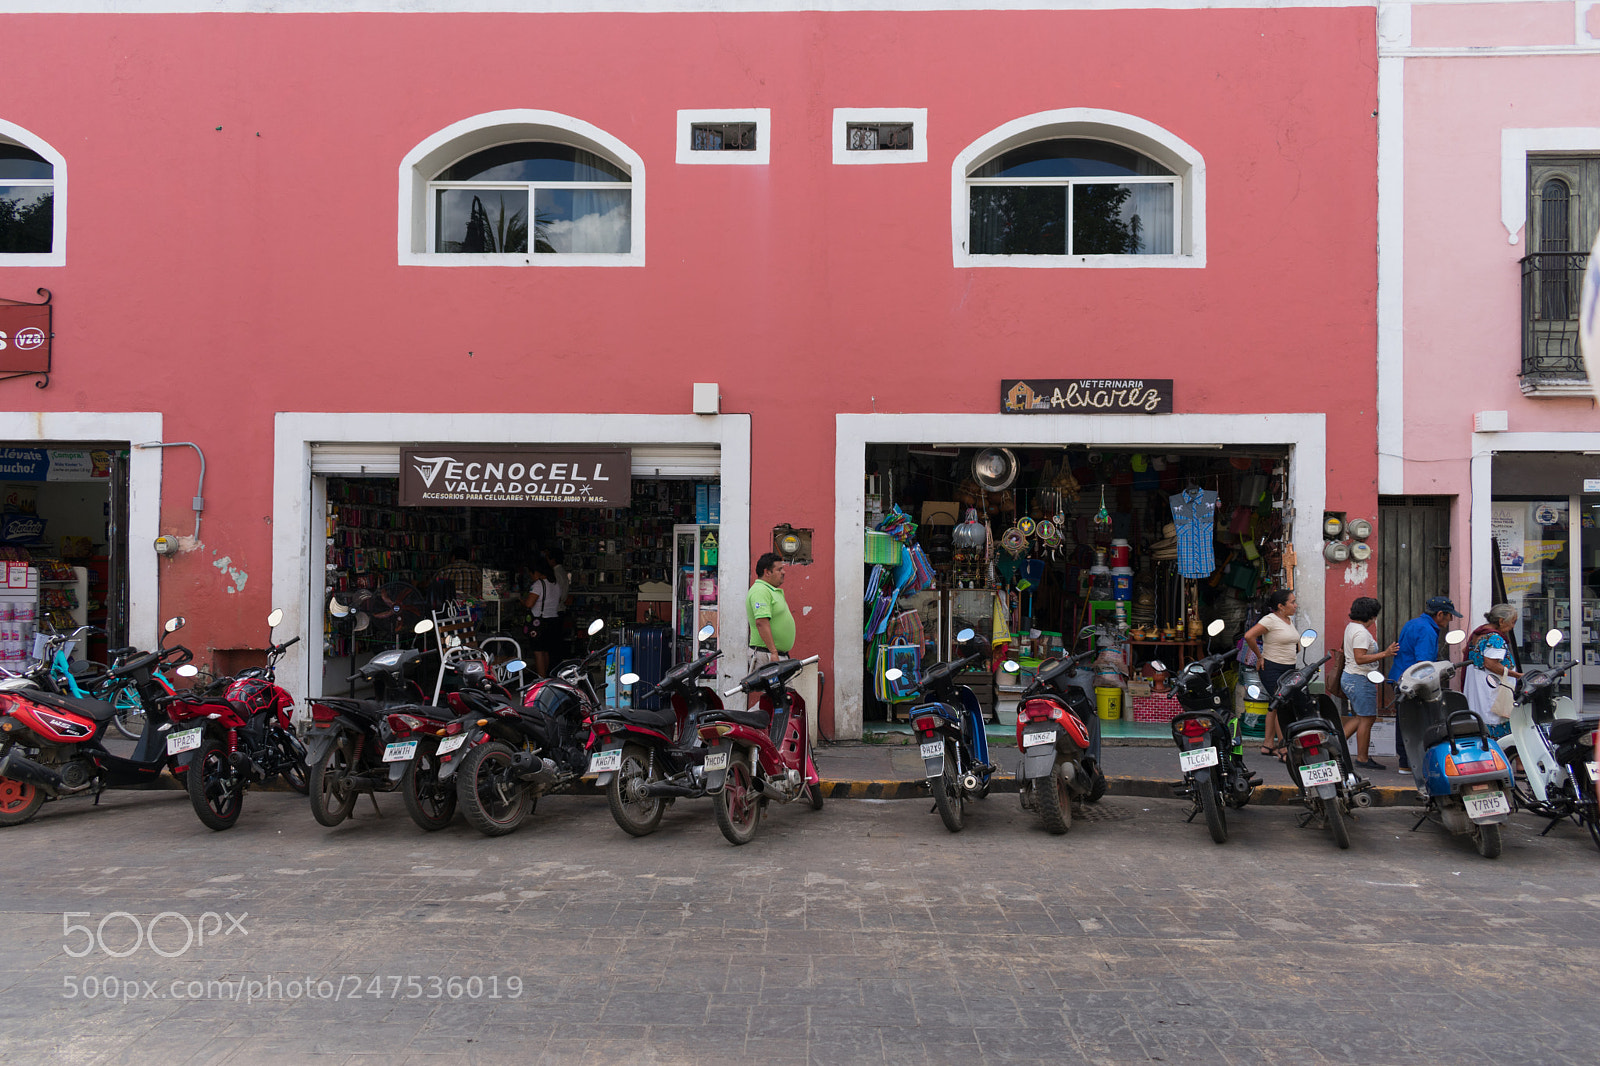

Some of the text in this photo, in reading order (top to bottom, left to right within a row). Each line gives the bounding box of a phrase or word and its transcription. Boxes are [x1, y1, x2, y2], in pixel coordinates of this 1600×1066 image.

[19, 334, 41, 346] yza
[1080, 380, 1144, 389] VETERINARIA
[413, 455, 609, 488] TECNOCELL
[445, 481, 576, 495] VALLADOLID
[423, 492, 464, 500] ACCESORIOS
[173, 735, 195, 748] TPA2R
[1307, 768, 1333, 781] Z8EW3
[1471, 797, 1500, 811] Y7RY5
